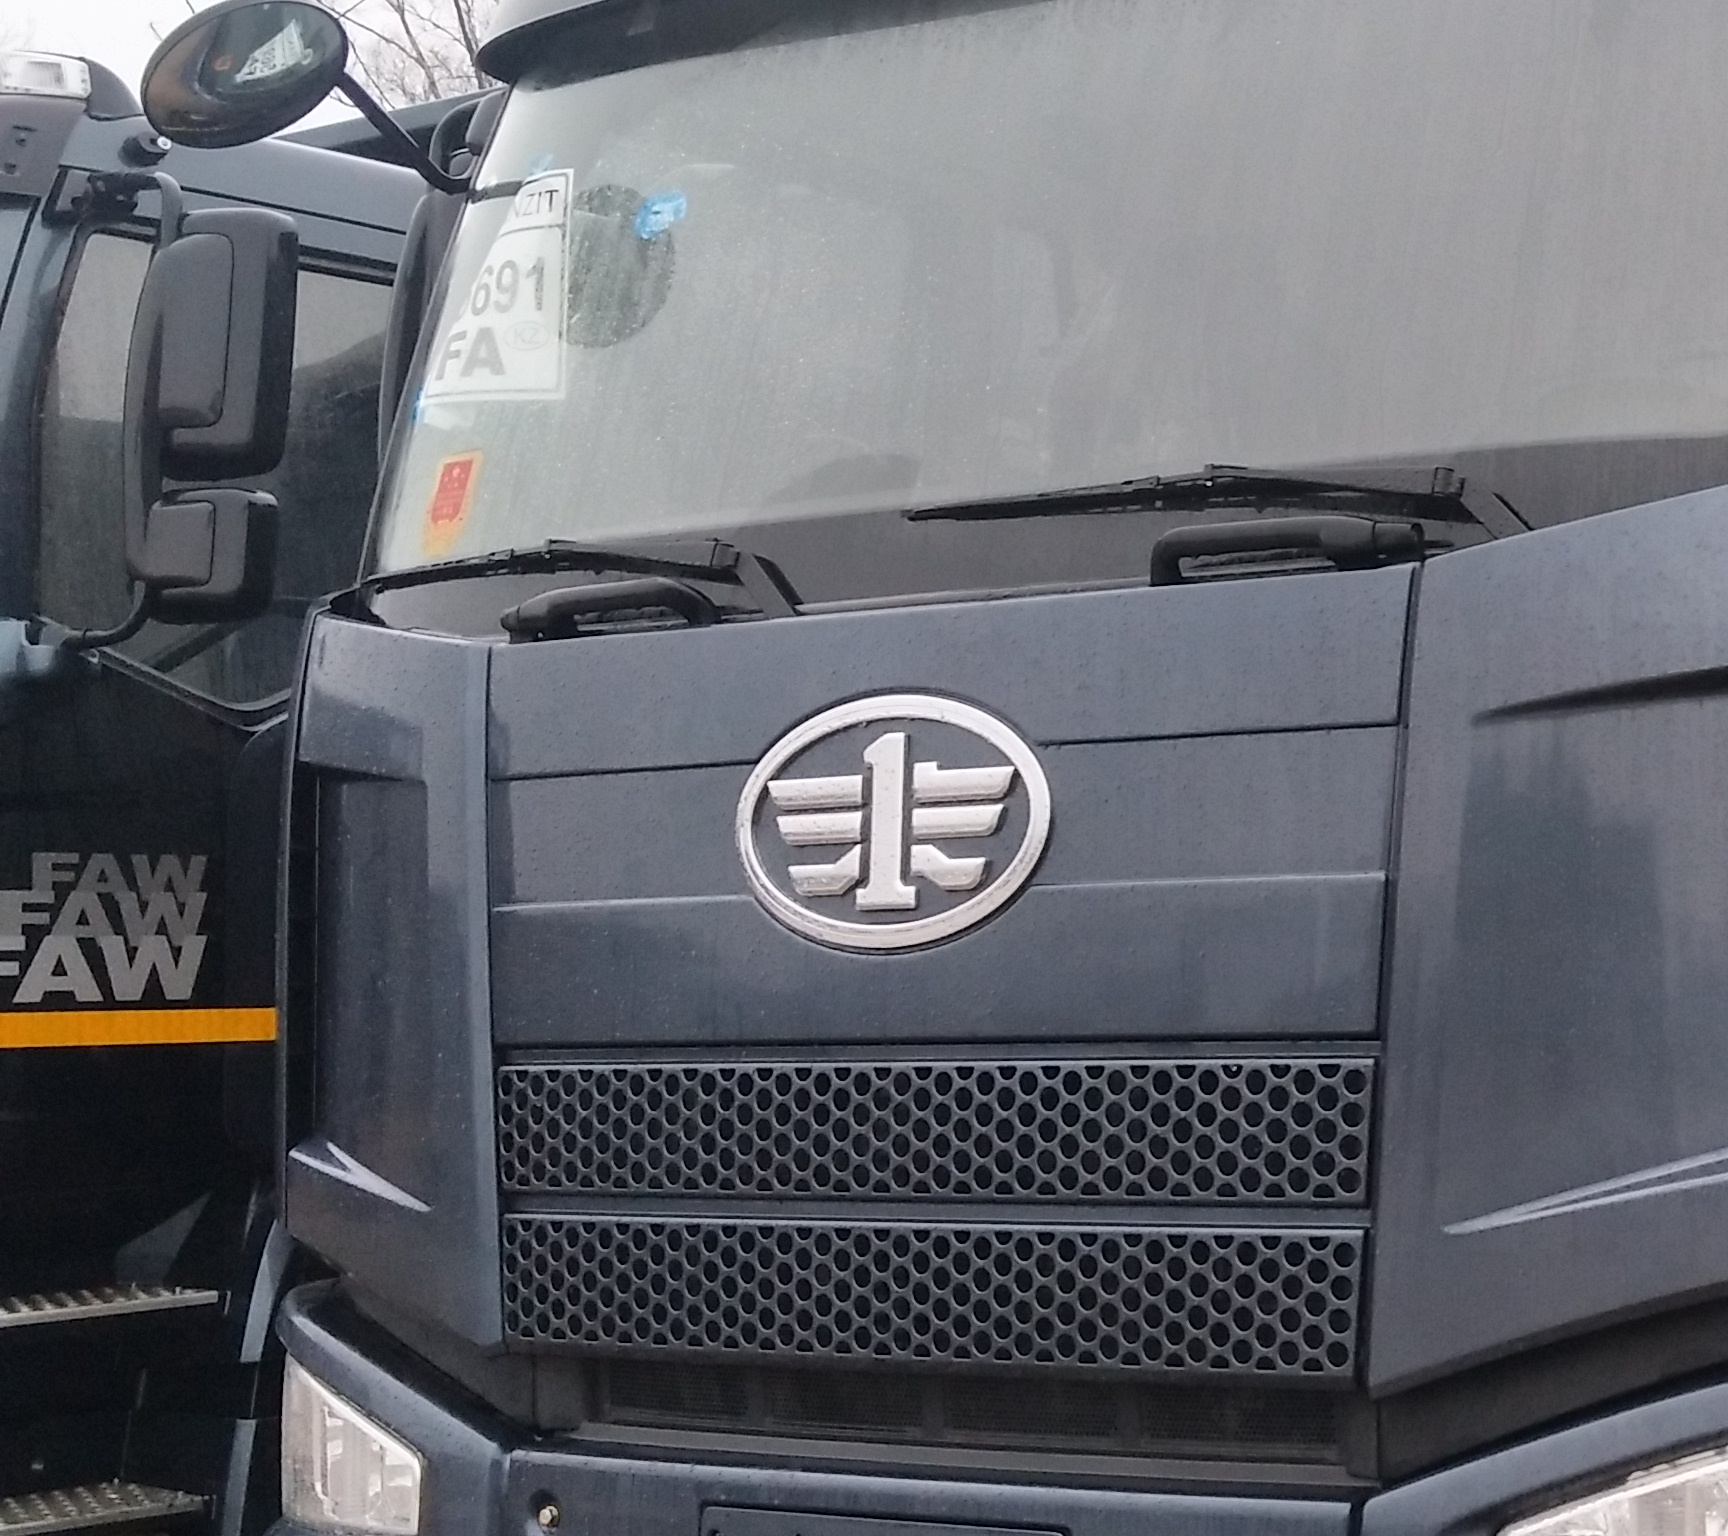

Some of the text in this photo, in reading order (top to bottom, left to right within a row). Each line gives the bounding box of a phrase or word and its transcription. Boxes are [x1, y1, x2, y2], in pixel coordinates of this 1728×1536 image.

[471, 257, 546, 316] 691
[434, 326, 506, 381] FA
[32, 852, 208, 904] FAW
[0, 889, 208, 947] FAW
